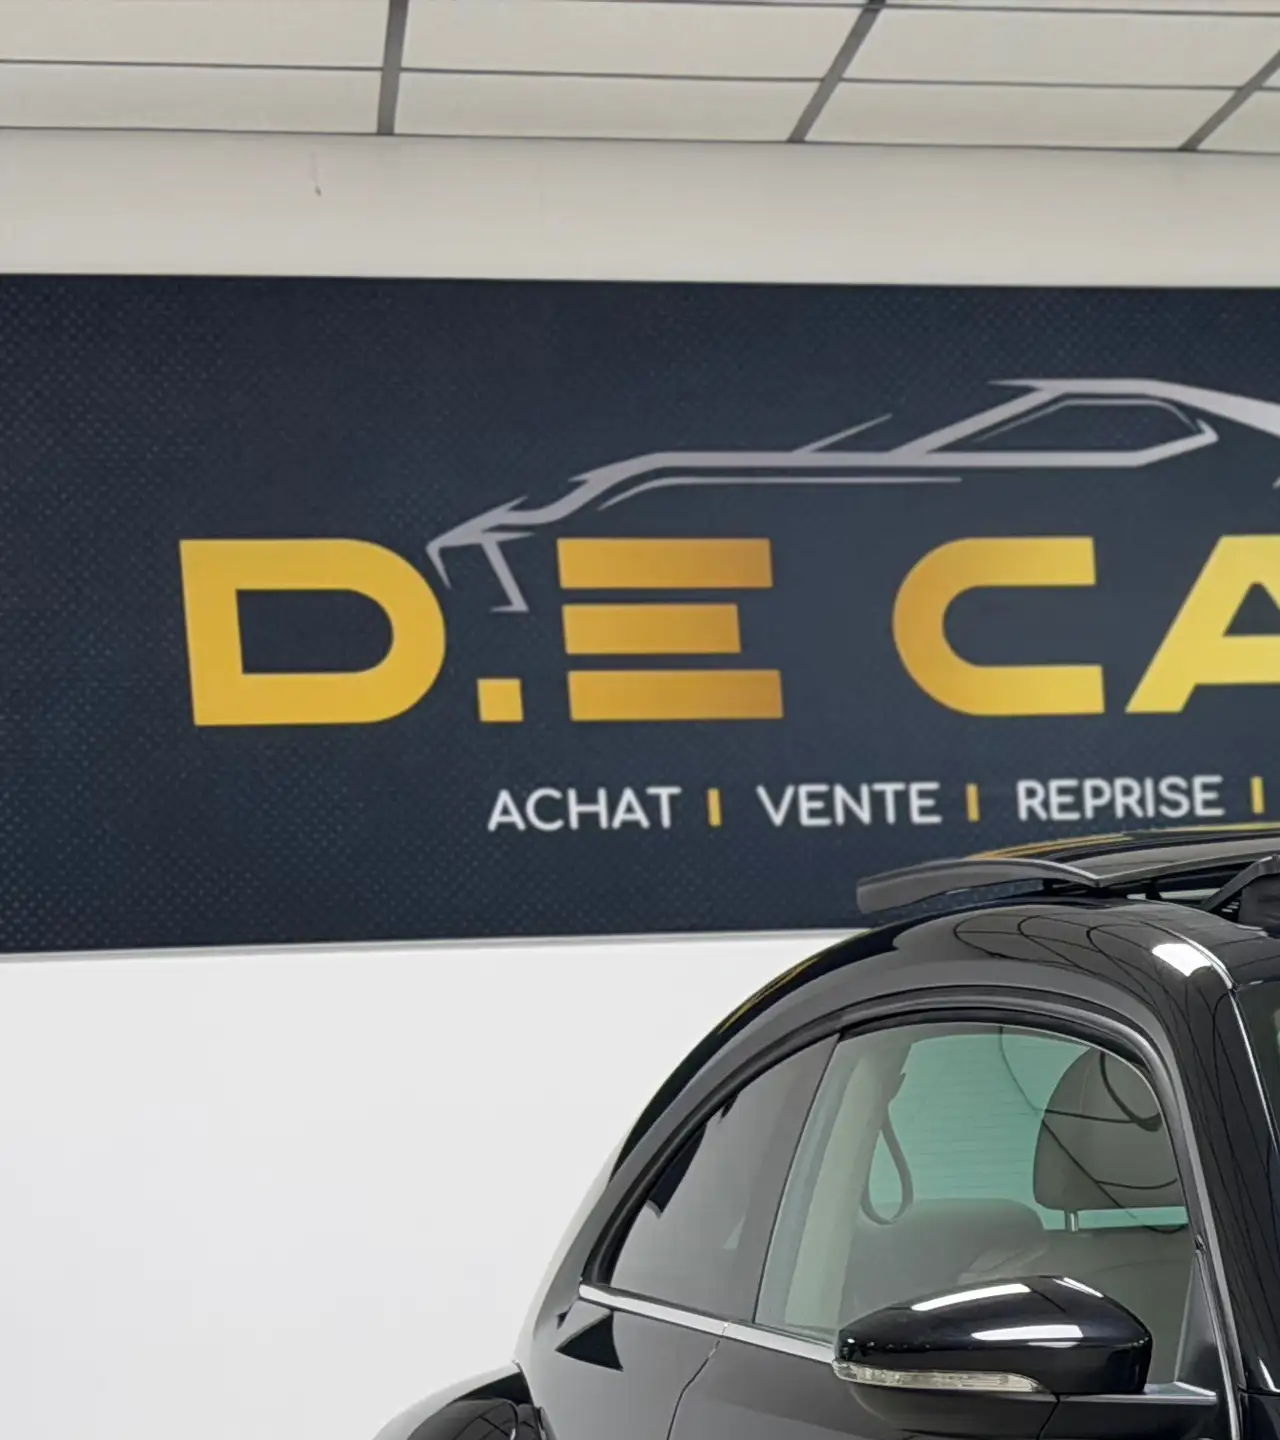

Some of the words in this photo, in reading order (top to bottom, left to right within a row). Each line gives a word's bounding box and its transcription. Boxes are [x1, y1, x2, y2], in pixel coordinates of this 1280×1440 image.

[179, 536, 784, 727] D.E
[487, 784, 683, 832] ACHAT
[756, 780, 942, 827] VENTE
[1016, 775, 1225, 822] REPRISE
